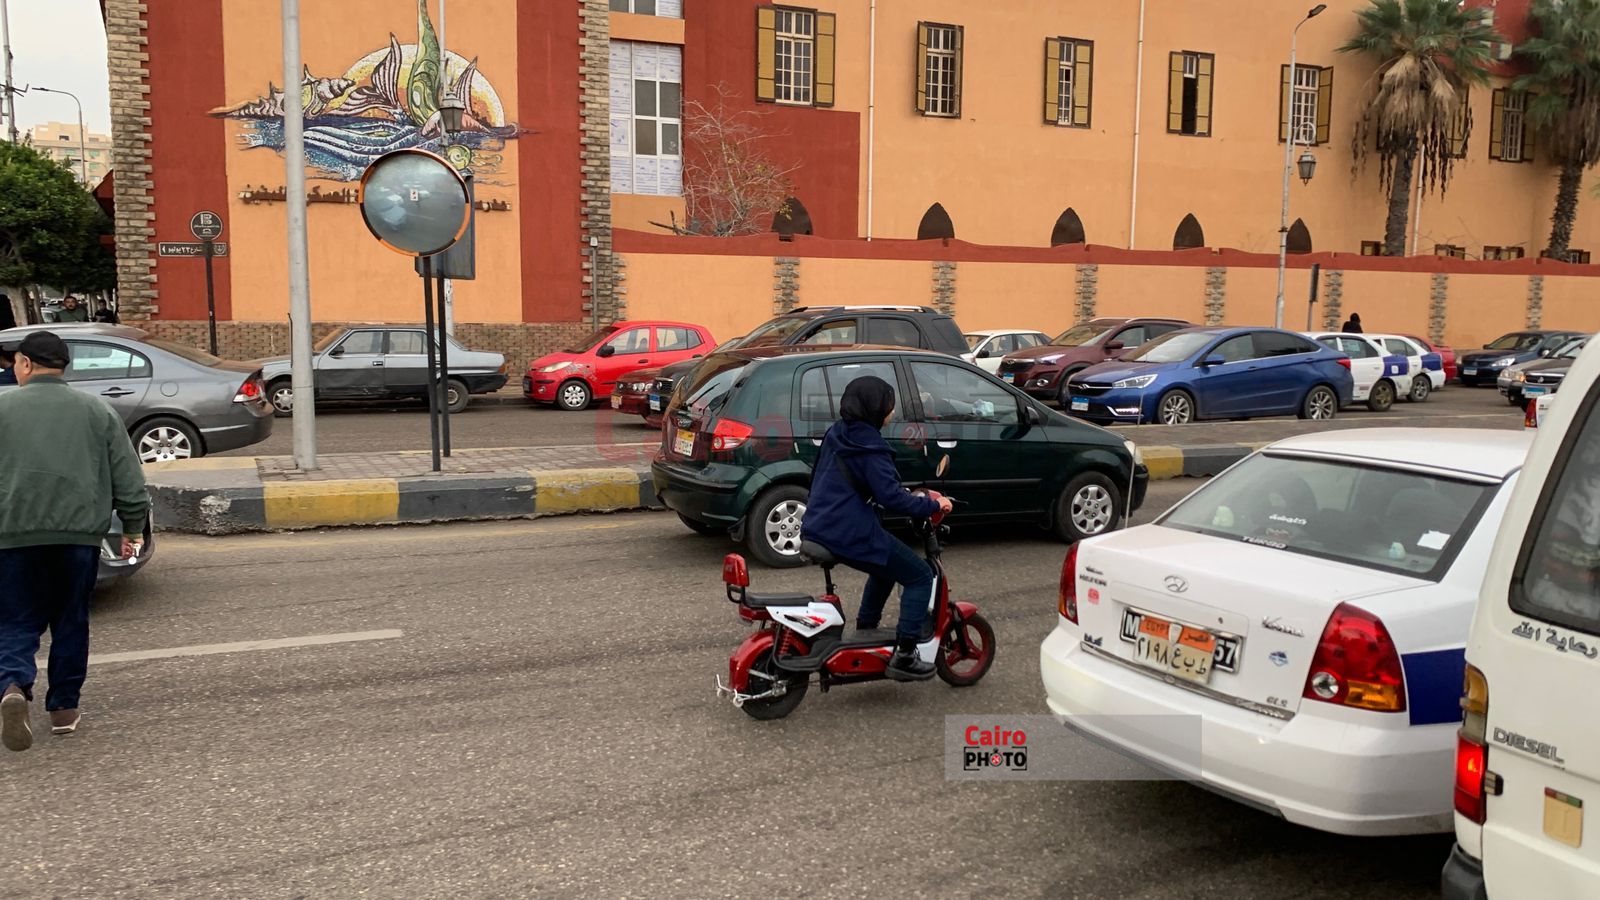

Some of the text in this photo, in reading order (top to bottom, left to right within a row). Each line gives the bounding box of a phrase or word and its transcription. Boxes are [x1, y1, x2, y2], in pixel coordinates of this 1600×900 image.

[1512, 621, 1598, 659] رعاية الله
[1493, 727, 1565, 764] DIESEL
